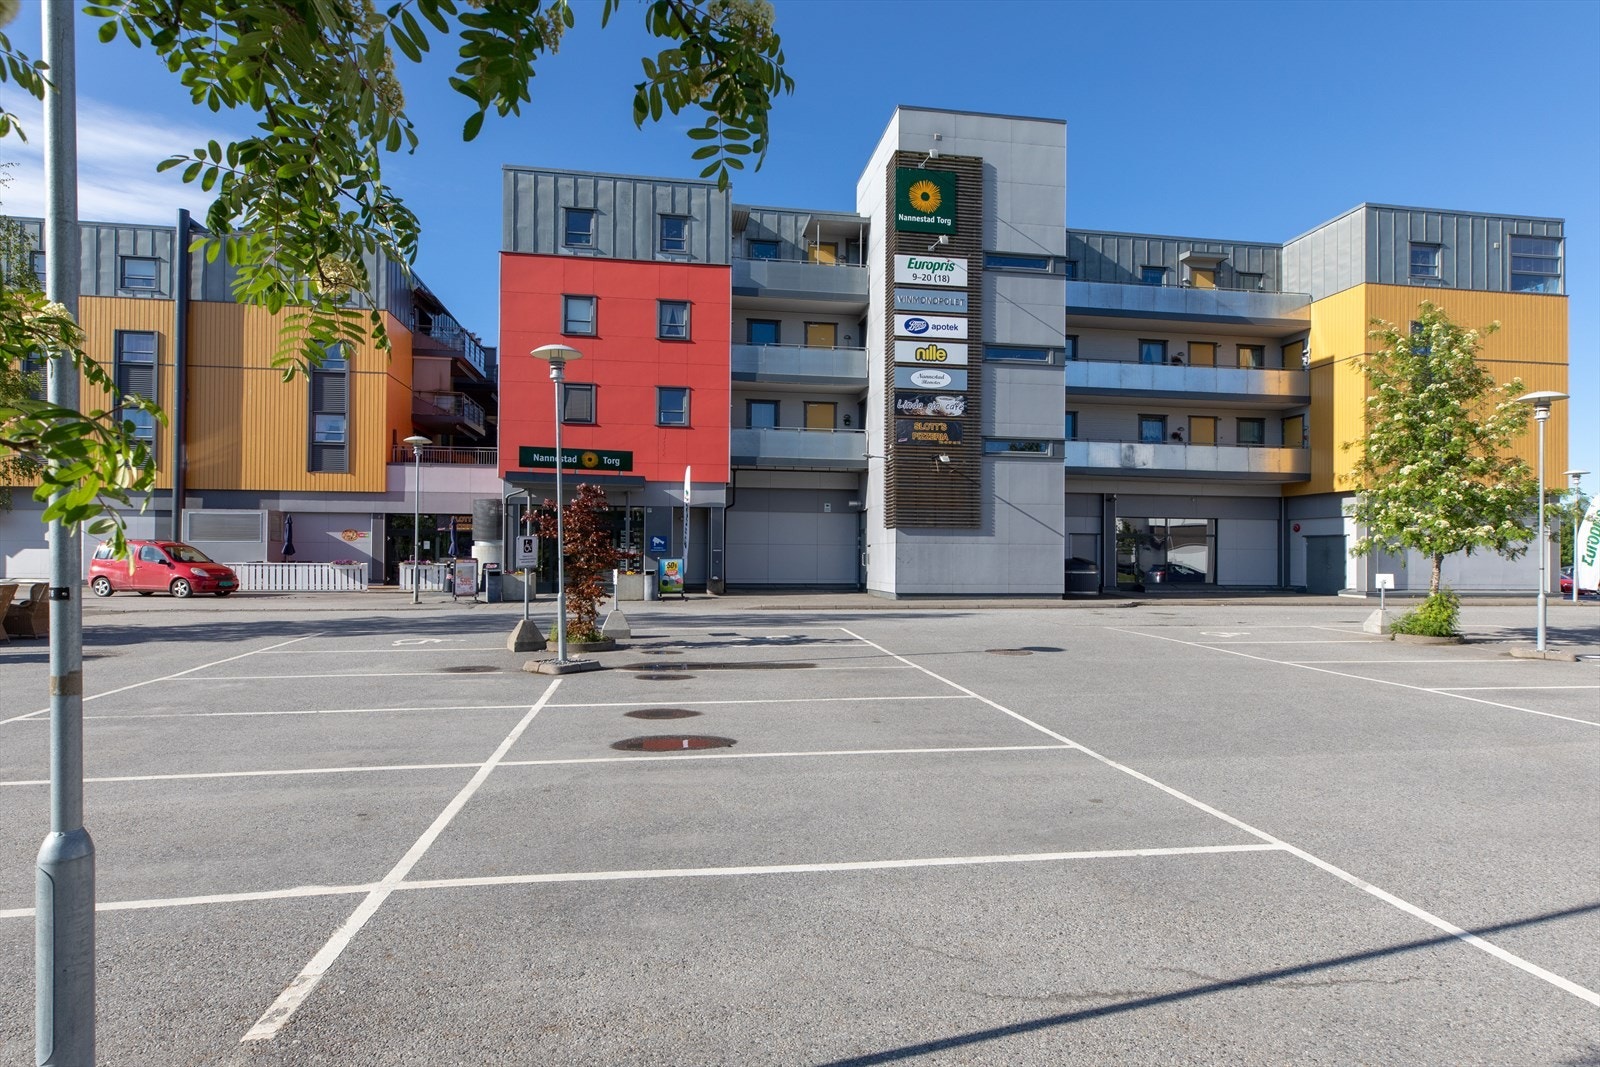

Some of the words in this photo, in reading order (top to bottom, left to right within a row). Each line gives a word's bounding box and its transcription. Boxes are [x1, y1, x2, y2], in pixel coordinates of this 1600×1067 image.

[898, 213, 935, 224] Nannestad
[937, 216, 952, 226] Torg
[907, 257, 955, 274] Europris
[934, 274, 950, 283] (18)
[896, 295, 964, 306] VINMONOPOLET
[931, 323, 959, 332] apotek
[915, 344, 947, 362] nille
[603, 456, 620, 467] Torg
